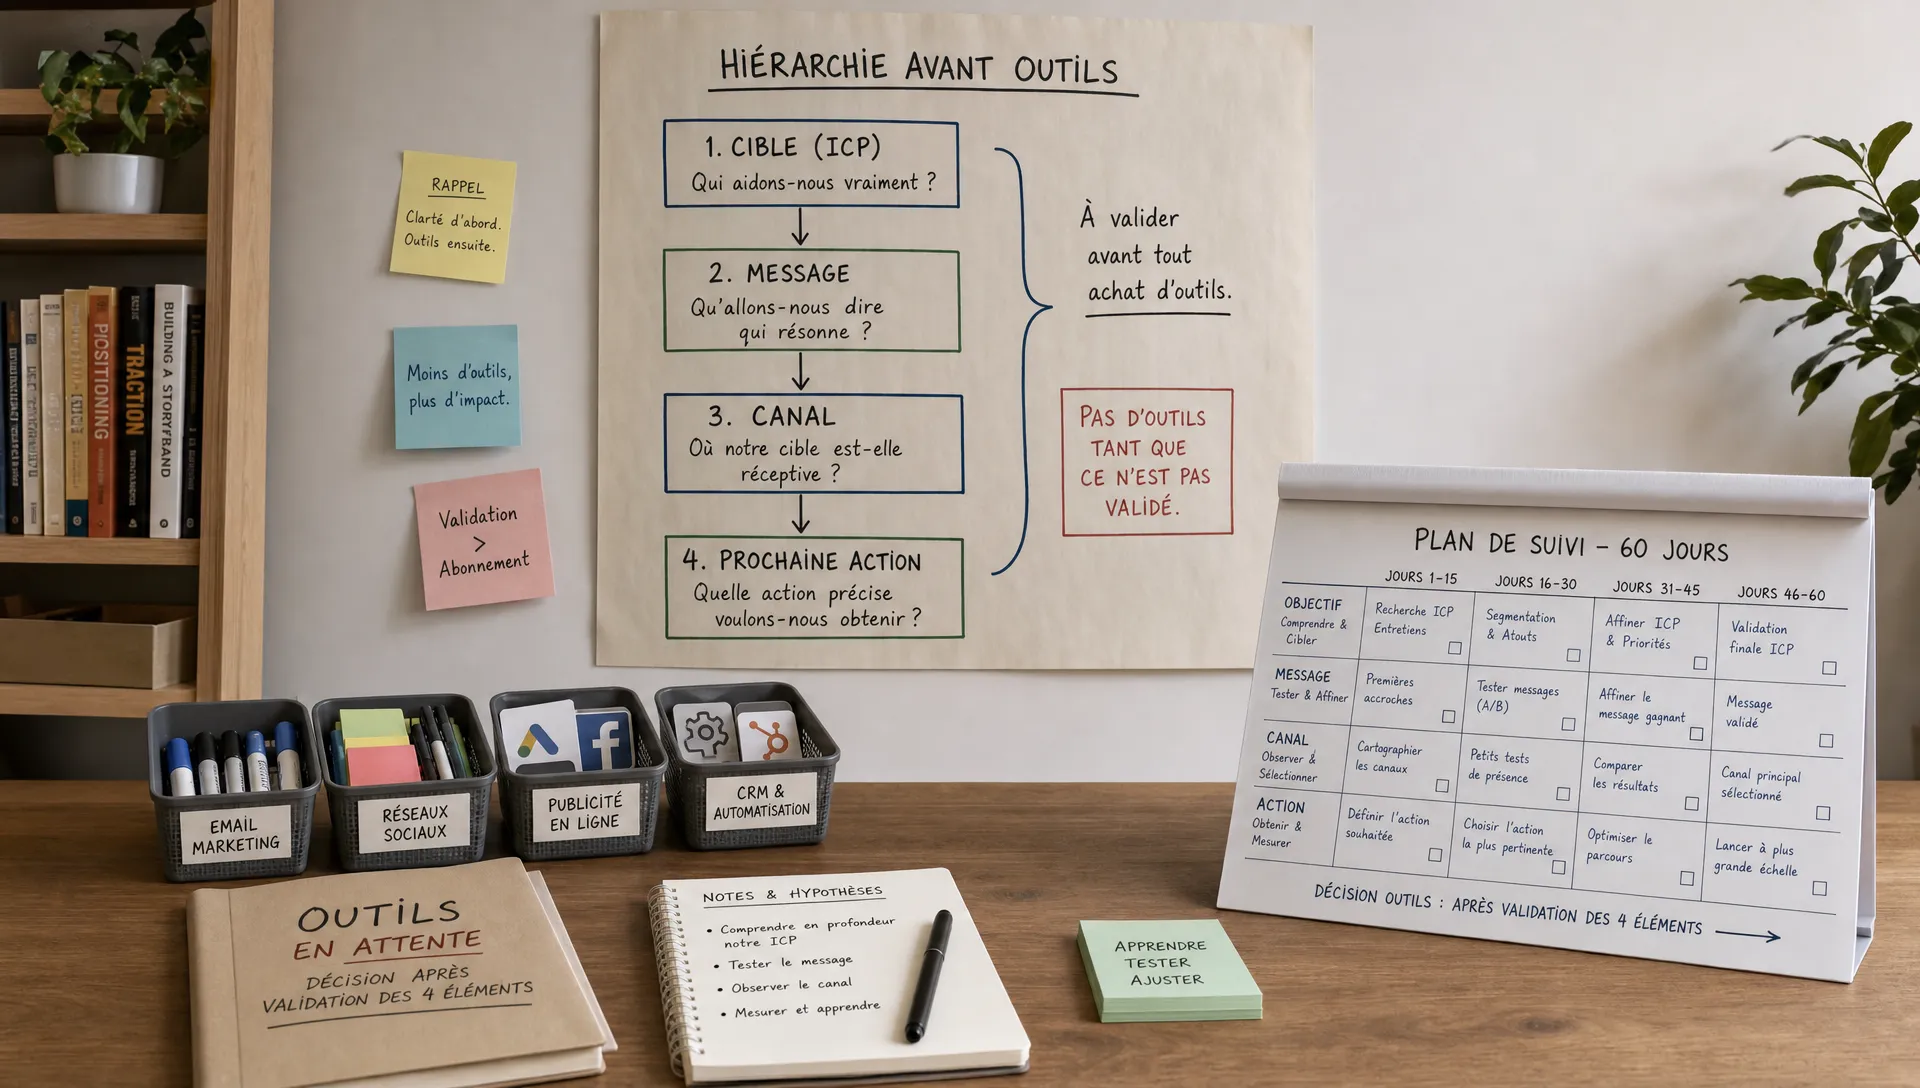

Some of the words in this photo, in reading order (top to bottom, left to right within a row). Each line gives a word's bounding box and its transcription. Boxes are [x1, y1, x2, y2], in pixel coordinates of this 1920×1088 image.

[904, 50, 994, 81] AVANT
[705, 135, 722, 158] 1.
[731, 136, 798, 157] CIBLE
[814, 132, 881, 162] (ICP)
[432, 177, 485, 195] RAPPEL
[405, 209, 444, 226] Clarté
[450, 213, 502, 231] d'abord.
[1079, 198, 1095, 229] À
[1110, 205, 1180, 228] valider
[404, 232, 439, 248] Outils
[447, 238, 496, 253] ensuite.
[1087, 243, 1143, 265] avant
[1153, 243, 1193, 265] tout
[708, 261, 732, 284] 2.
[747, 262, 850, 284] MESSAGE
[1088, 279, 1145, 301] achat
[1157, 278, 1232, 300] d'outils.
[690, 296, 830, 318] Qu'allons-nous
[844, 295, 884, 315] dire
[163, 301, 175, 364] BUILDING
[162, 368, 174, 378] A
[407, 363, 449, 382] Moins
[457, 362, 512, 382] d'outils,
[126, 343, 145, 436] TRACTION
[409, 391, 437, 416] plus
[444, 389, 510, 413] d'impact.
[708, 404, 732, 427] 3.
[752, 404, 836, 427] CANAL
[1080, 404, 1115, 428] PAS
[1127, 407, 1206, 428] D'OUTILS
[689, 437, 714, 457] Où
[725, 438, 769, 457] notre
[779, 438, 820, 457] cible
[833, 438, 903, 457] est-elle
[1090, 439, 1142, 457] TANT
[1151, 439, 1187, 458] QUE
[1080, 468, 1105, 487] CE
[1116, 467, 1171, 487] N'EST
[1180, 467, 1211, 486] PAS
[438, 505, 518, 530] Validation
[1415, 526, 1474, 552] PLAN
[1489, 532, 1517, 554] DE
[1620, 536, 1648, 559] 60
[1662, 539, 1729, 563] JOURS
[439, 549, 530, 579] Abonnement
[1384, 569, 1423, 583] JOURS
[1429, 571, 1458, 585] 1-15
[1494, 574, 1534, 589] JOURS
[1539, 576, 1577, 590] 16-30
[693, 581, 751, 603] Quelle
[761, 582, 816, 601] action
[828, 583, 893, 609] précise
[1612, 580, 1653, 594] JOURS
[1660, 582, 1701, 597] 31-45
[1737, 585, 1778, 600] JOURS
[1783, 587, 1826, 602] 46-60
[1284, 596, 1343, 611] OBJECTIF
[1375, 601, 1427, 617] Recherche
[1433, 605, 1455, 618] ICP
[1486, 607, 1556, 626] Segmentation
[1604, 613, 1646, 628] Affiner
[1654, 616, 1681, 630] ICP
[1374, 621, 1427, 636] Entretiens
[1731, 619, 1788, 635] Validation
[1286, 633, 1318, 646] Cibler
[1729, 639, 1762, 655] finale
[1769, 642, 1795, 656] ICP
[1274, 667, 1331, 683] MESSAGE
[1366, 672, 1414, 688] Premières
[1476, 679, 1508, 693] Tester
[1513, 686, 1560, 701] messages
[1598, 687, 1636, 702] Affiner
[1642, 690, 1652, 703] le
[1363, 693, 1413, 706] accroches
[1476, 697, 1509, 715] (A/B)
[1726, 694, 1773, 714] Message
[1598, 711, 1640, 725] message
[1645, 711, 1686, 727] gagnant
[1725, 715, 1759, 729] validé
[1266, 730, 1309, 746] CANAL
[1357, 739, 1423, 759] Cartographier
[1470, 747, 1499, 762] Petits
[1504, 751, 1530, 765] tests
[1355, 759, 1369, 771] les
[1372, 764, 1408, 774] canaux
[1593, 756, 1644, 775] Comparer
[1258, 767, 1318, 783] Sélectionner
[1468, 767, 1481, 780] de
[1484, 770, 1529, 785] présence
[1721, 765, 1752, 780] Canal
[1756, 770, 1802, 787] principal
[1592, 776, 1607, 789] les
[1612, 778, 1659, 793] résultats
[1721, 786, 1782, 802] sélectionné
[382, 804, 449, 823] RÉSEAUX
[1256, 796, 1306, 814] ACTION
[550, 817, 570, 832] EN
[1347, 807, 1385, 822] Définir
[1390, 811, 1430, 826] l'action
[383, 824, 447, 843] SOCIAUX
[1345, 827, 1394, 842] souhaitée
[1463, 817, 1500, 832] Choisir
[1506, 820, 1544, 836] l'action
[1251, 834, 1292, 848] Mesurer
[1587, 827, 1638, 845] Optimiser
[1643, 832, 1653, 845] le
[1462, 836, 1472, 849] la
[1475, 838, 1497, 855] plus
[1501, 842, 1554, 857] pertinente
[1715, 837, 1754, 853] Lancer
[1759, 841, 1767, 854] à
[1772, 842, 1794, 860] plus
[1586, 852, 1633, 865] parcours
[1713, 860, 1753, 875] grande
[1759, 862, 1798, 877] échelle
[703, 891, 755, 903] NOTES
[766, 889, 777, 900] &
[789, 885, 883, 899] HYPOTHÈSES
[720, 922, 796, 937] Comprendre
[827, 916, 896, 932] profondeur
[293, 939, 335, 961] EN
[352, 929, 481, 957] ATTENTE
[724, 938, 761, 949] notre
[770, 935, 797, 947] ICP
[1114, 940, 1207, 953] APPRENDRE
[727, 959, 772, 970] Tester
[781, 956, 793, 967] le
[801, 956, 854, 968] message
[1124, 957, 1191, 969] TESTER
[731, 982, 790, 994] Observer
[798, 979, 810, 990] le
[817, 976, 853, 989] canal
[1130, 974, 1205, 986] AJUSTER
[734, 1007, 788, 1019] Mesurer
[795, 1003, 809, 1015] et
[816, 999, 881, 1017] apprendre
